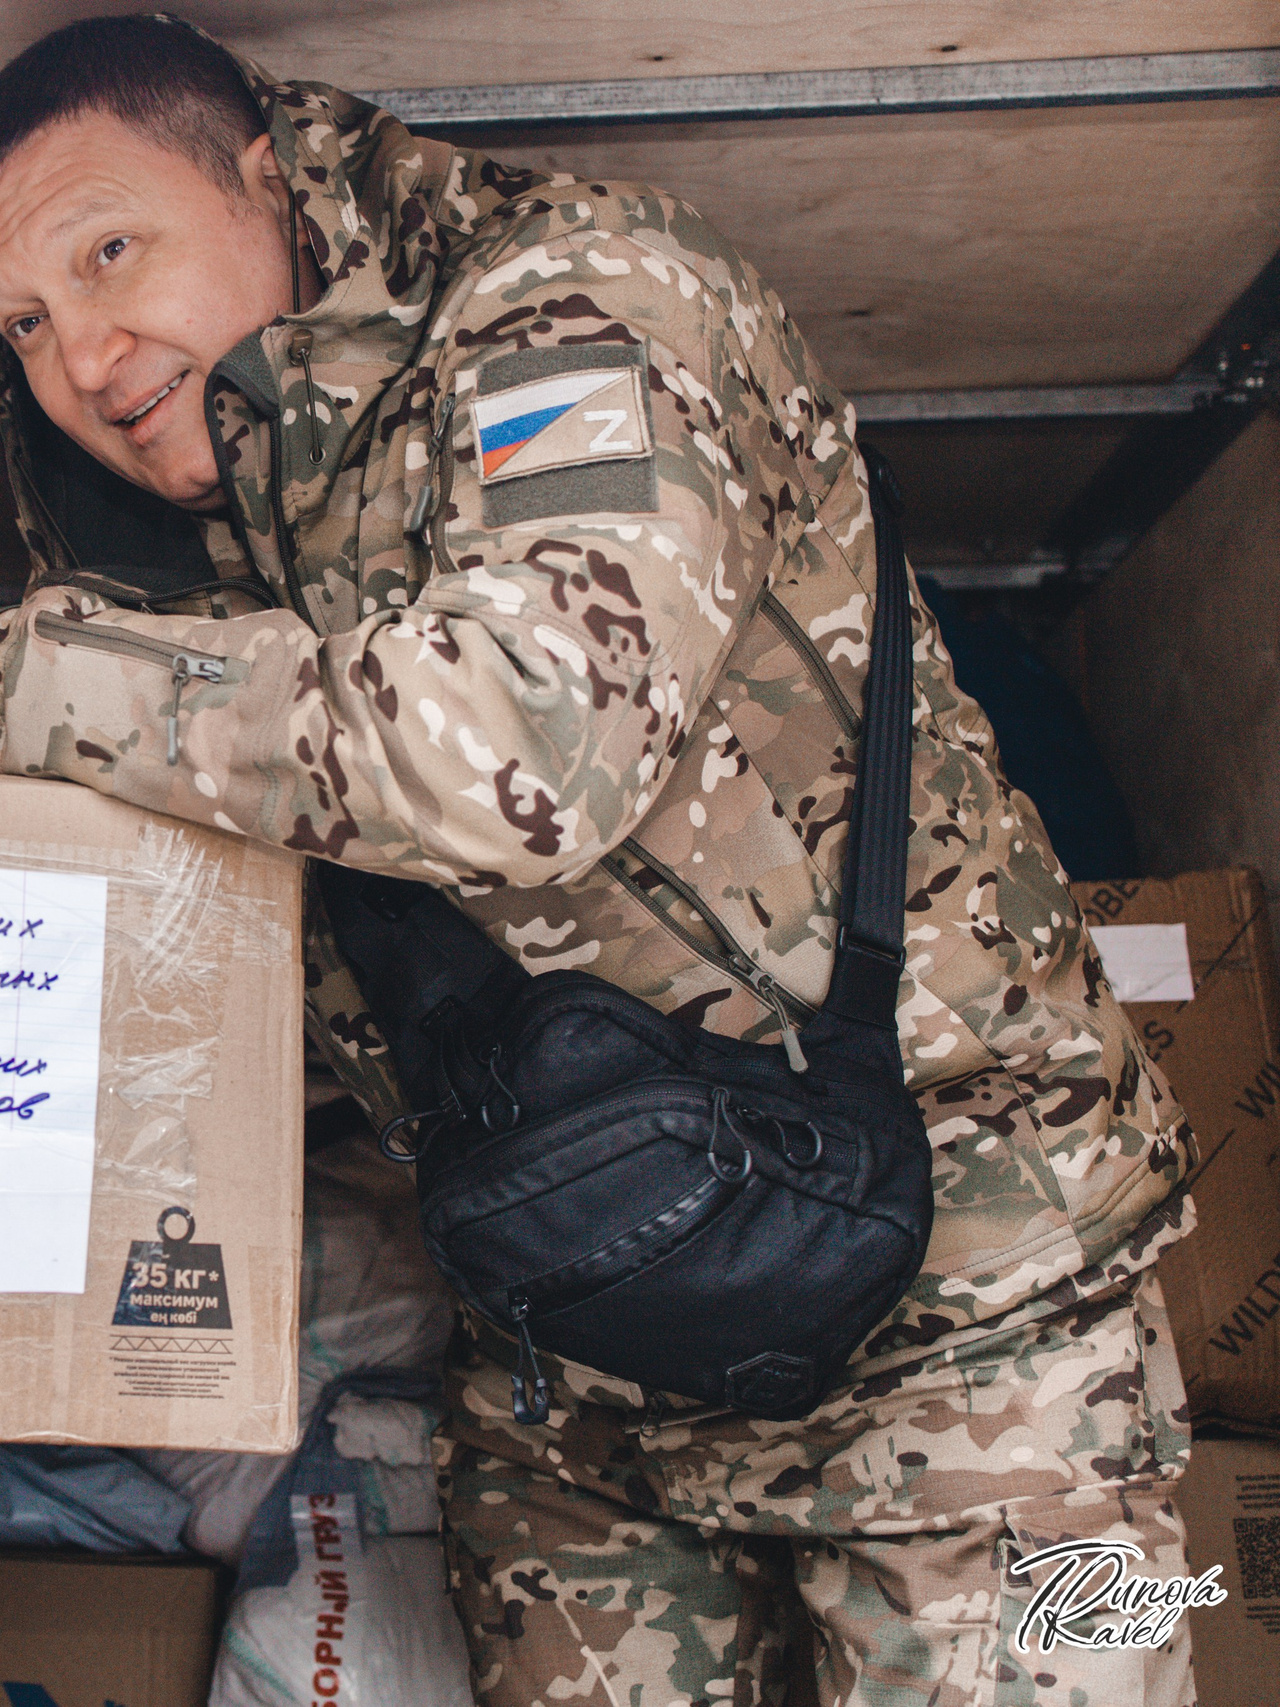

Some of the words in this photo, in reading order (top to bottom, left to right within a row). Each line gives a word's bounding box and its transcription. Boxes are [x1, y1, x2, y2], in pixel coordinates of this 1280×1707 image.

[583, 409, 634, 453] Z
[131, 1261, 168, 1289] 35
[129, 1293, 219, 1311] максимум
[1208, 1254, 1280, 1357] WILD
[312, 1571, 350, 1707] ОРНЫЙ
